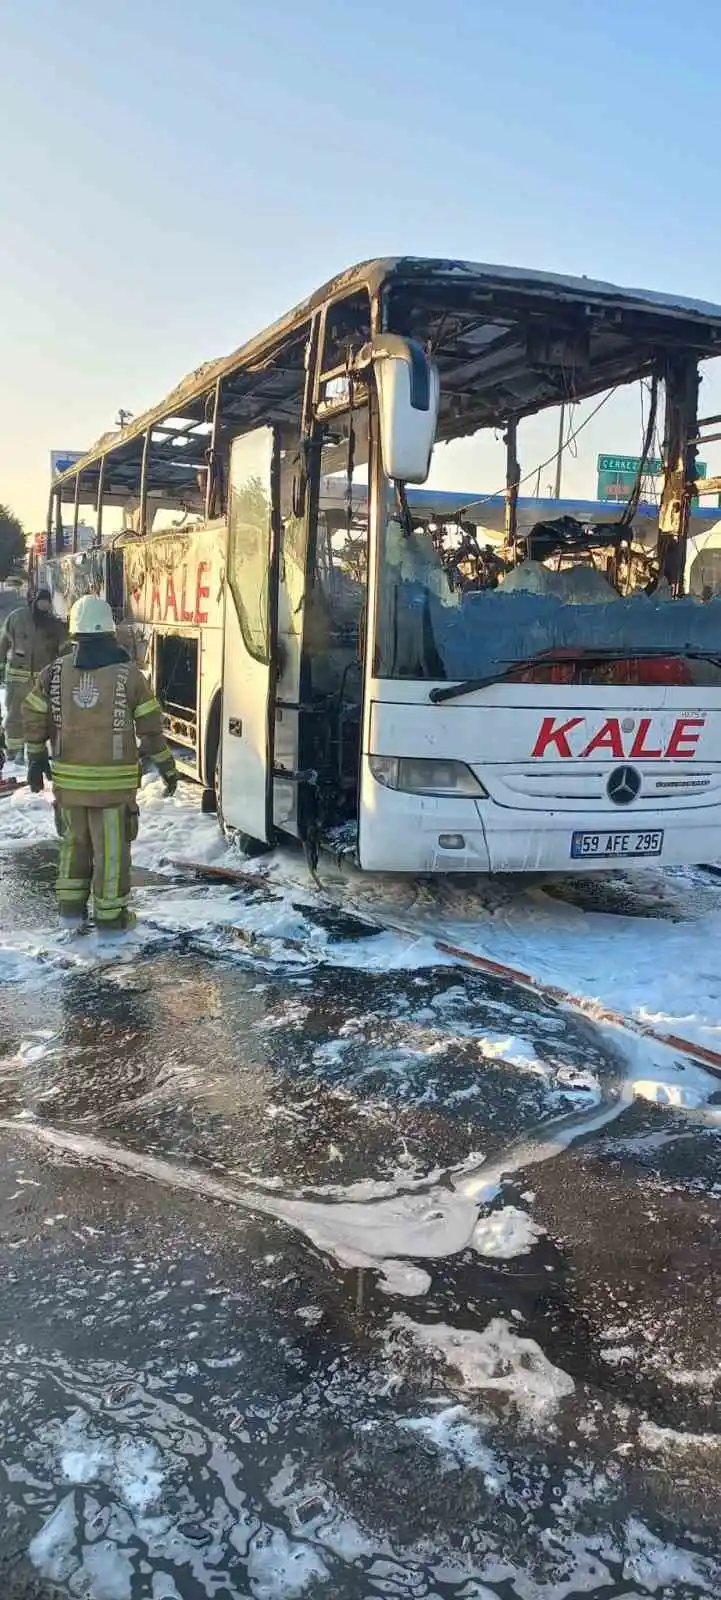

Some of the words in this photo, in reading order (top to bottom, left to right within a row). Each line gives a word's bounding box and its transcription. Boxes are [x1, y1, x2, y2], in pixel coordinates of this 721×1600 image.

[531, 717, 705, 758] KALE
[582, 836, 600, 853] 59
[606, 834, 630, 852] AFE
[635, 833, 660, 851] 295
